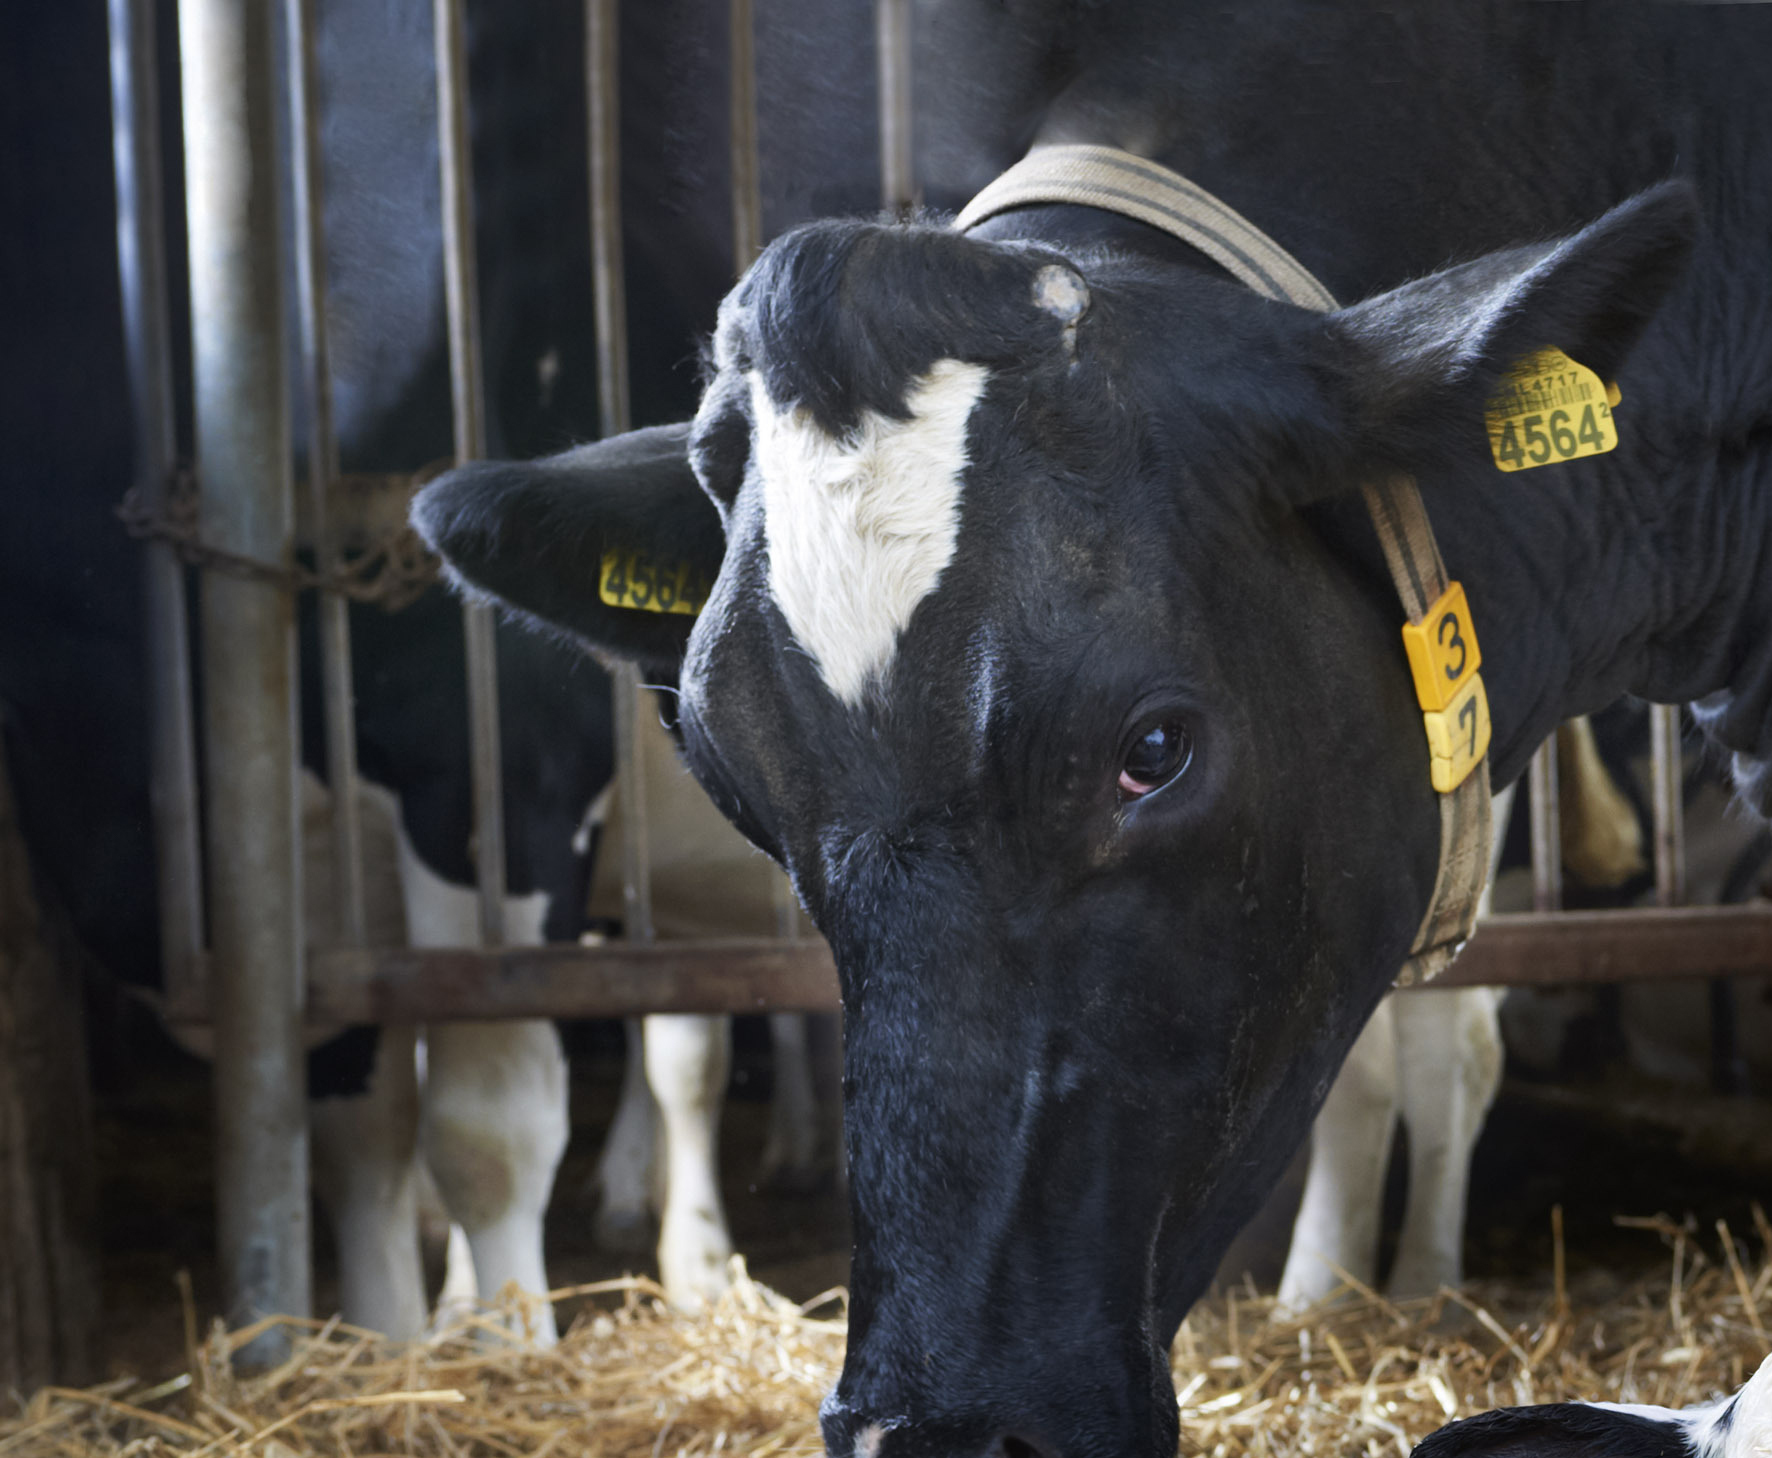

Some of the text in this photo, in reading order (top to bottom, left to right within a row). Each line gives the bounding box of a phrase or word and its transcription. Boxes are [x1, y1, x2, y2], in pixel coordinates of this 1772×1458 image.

[1500, 404, 1605, 468] 4564
[1438, 612, 1466, 680] 3
[1459, 696, 1477, 757] 7
